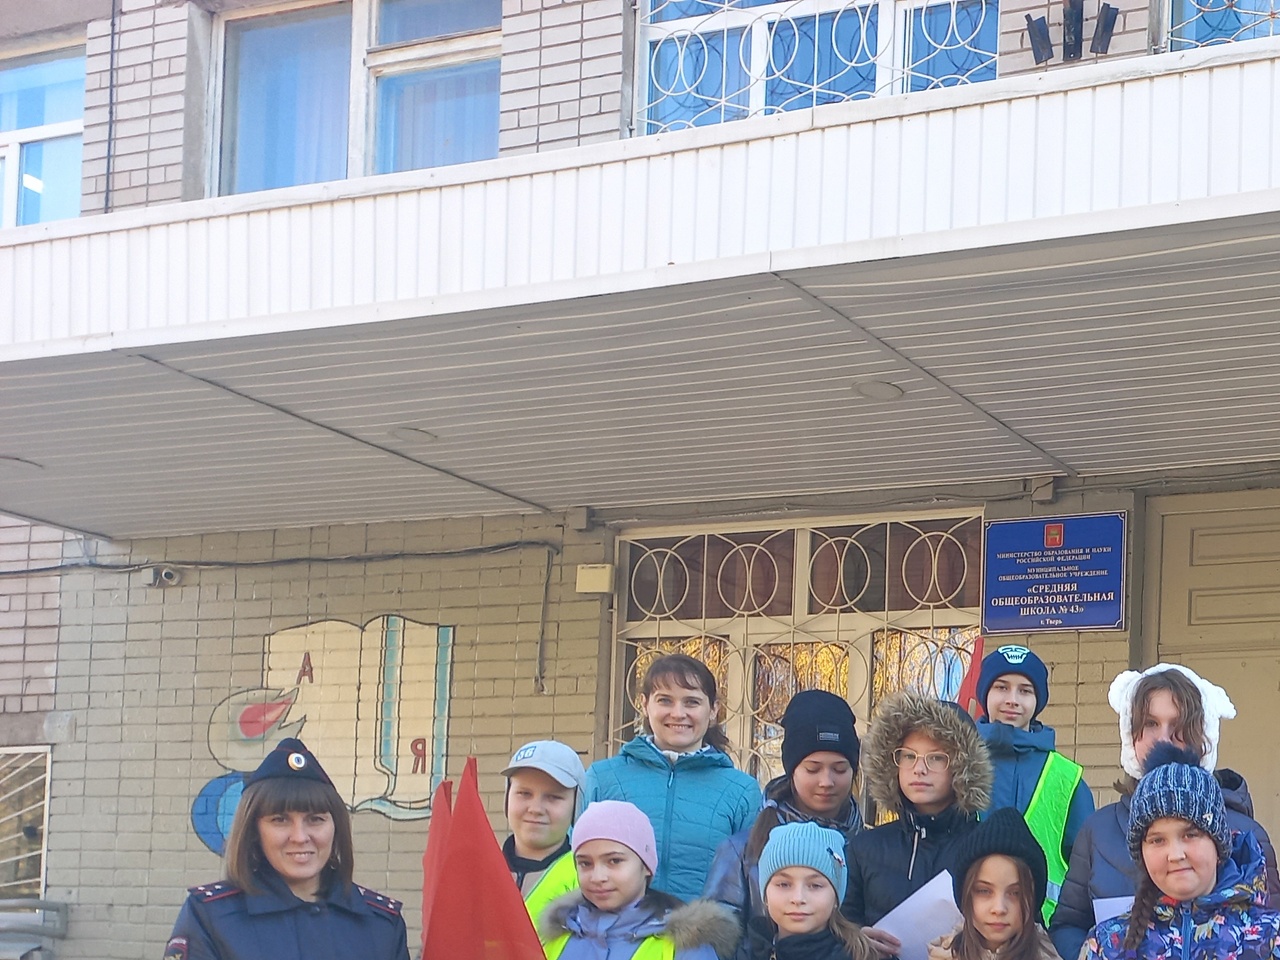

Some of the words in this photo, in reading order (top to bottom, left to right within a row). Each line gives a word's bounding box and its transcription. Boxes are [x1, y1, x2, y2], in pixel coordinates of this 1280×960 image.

[996, 551, 1042, 559] МИНИСТЕРСТВО
[1043, 548, 1084, 556] ОБРАЗОВАНИЯ
[1016, 556, 1055, 564] РОССИЙСКОЙ
[1056, 554, 1091, 562] ФЕДЕРАЦИИ
[1027, 565, 1079, 573] МУНИЦИПАЛЬНОЕ
[998, 573, 1068, 581] ОБЩЕОБРАЗОВАТЕЛЬНОЕ
[1069, 569, 1108, 577] УЧРЕЖДЕНИЕ
[1027, 583, 1077, 593] «СРЕДНЯЯ
[991, 592, 1115, 606] ОБЩЕОБРАЗОВАТЕЛЬНАЯ
[1020, 606, 1056, 616] ШКОЛА
[1058, 605, 1068, 614] №
[1069, 605, 1084, 613] 43»
[1046, 618, 1063, 626] Тверь
[410, 737, 427, 774] Я
